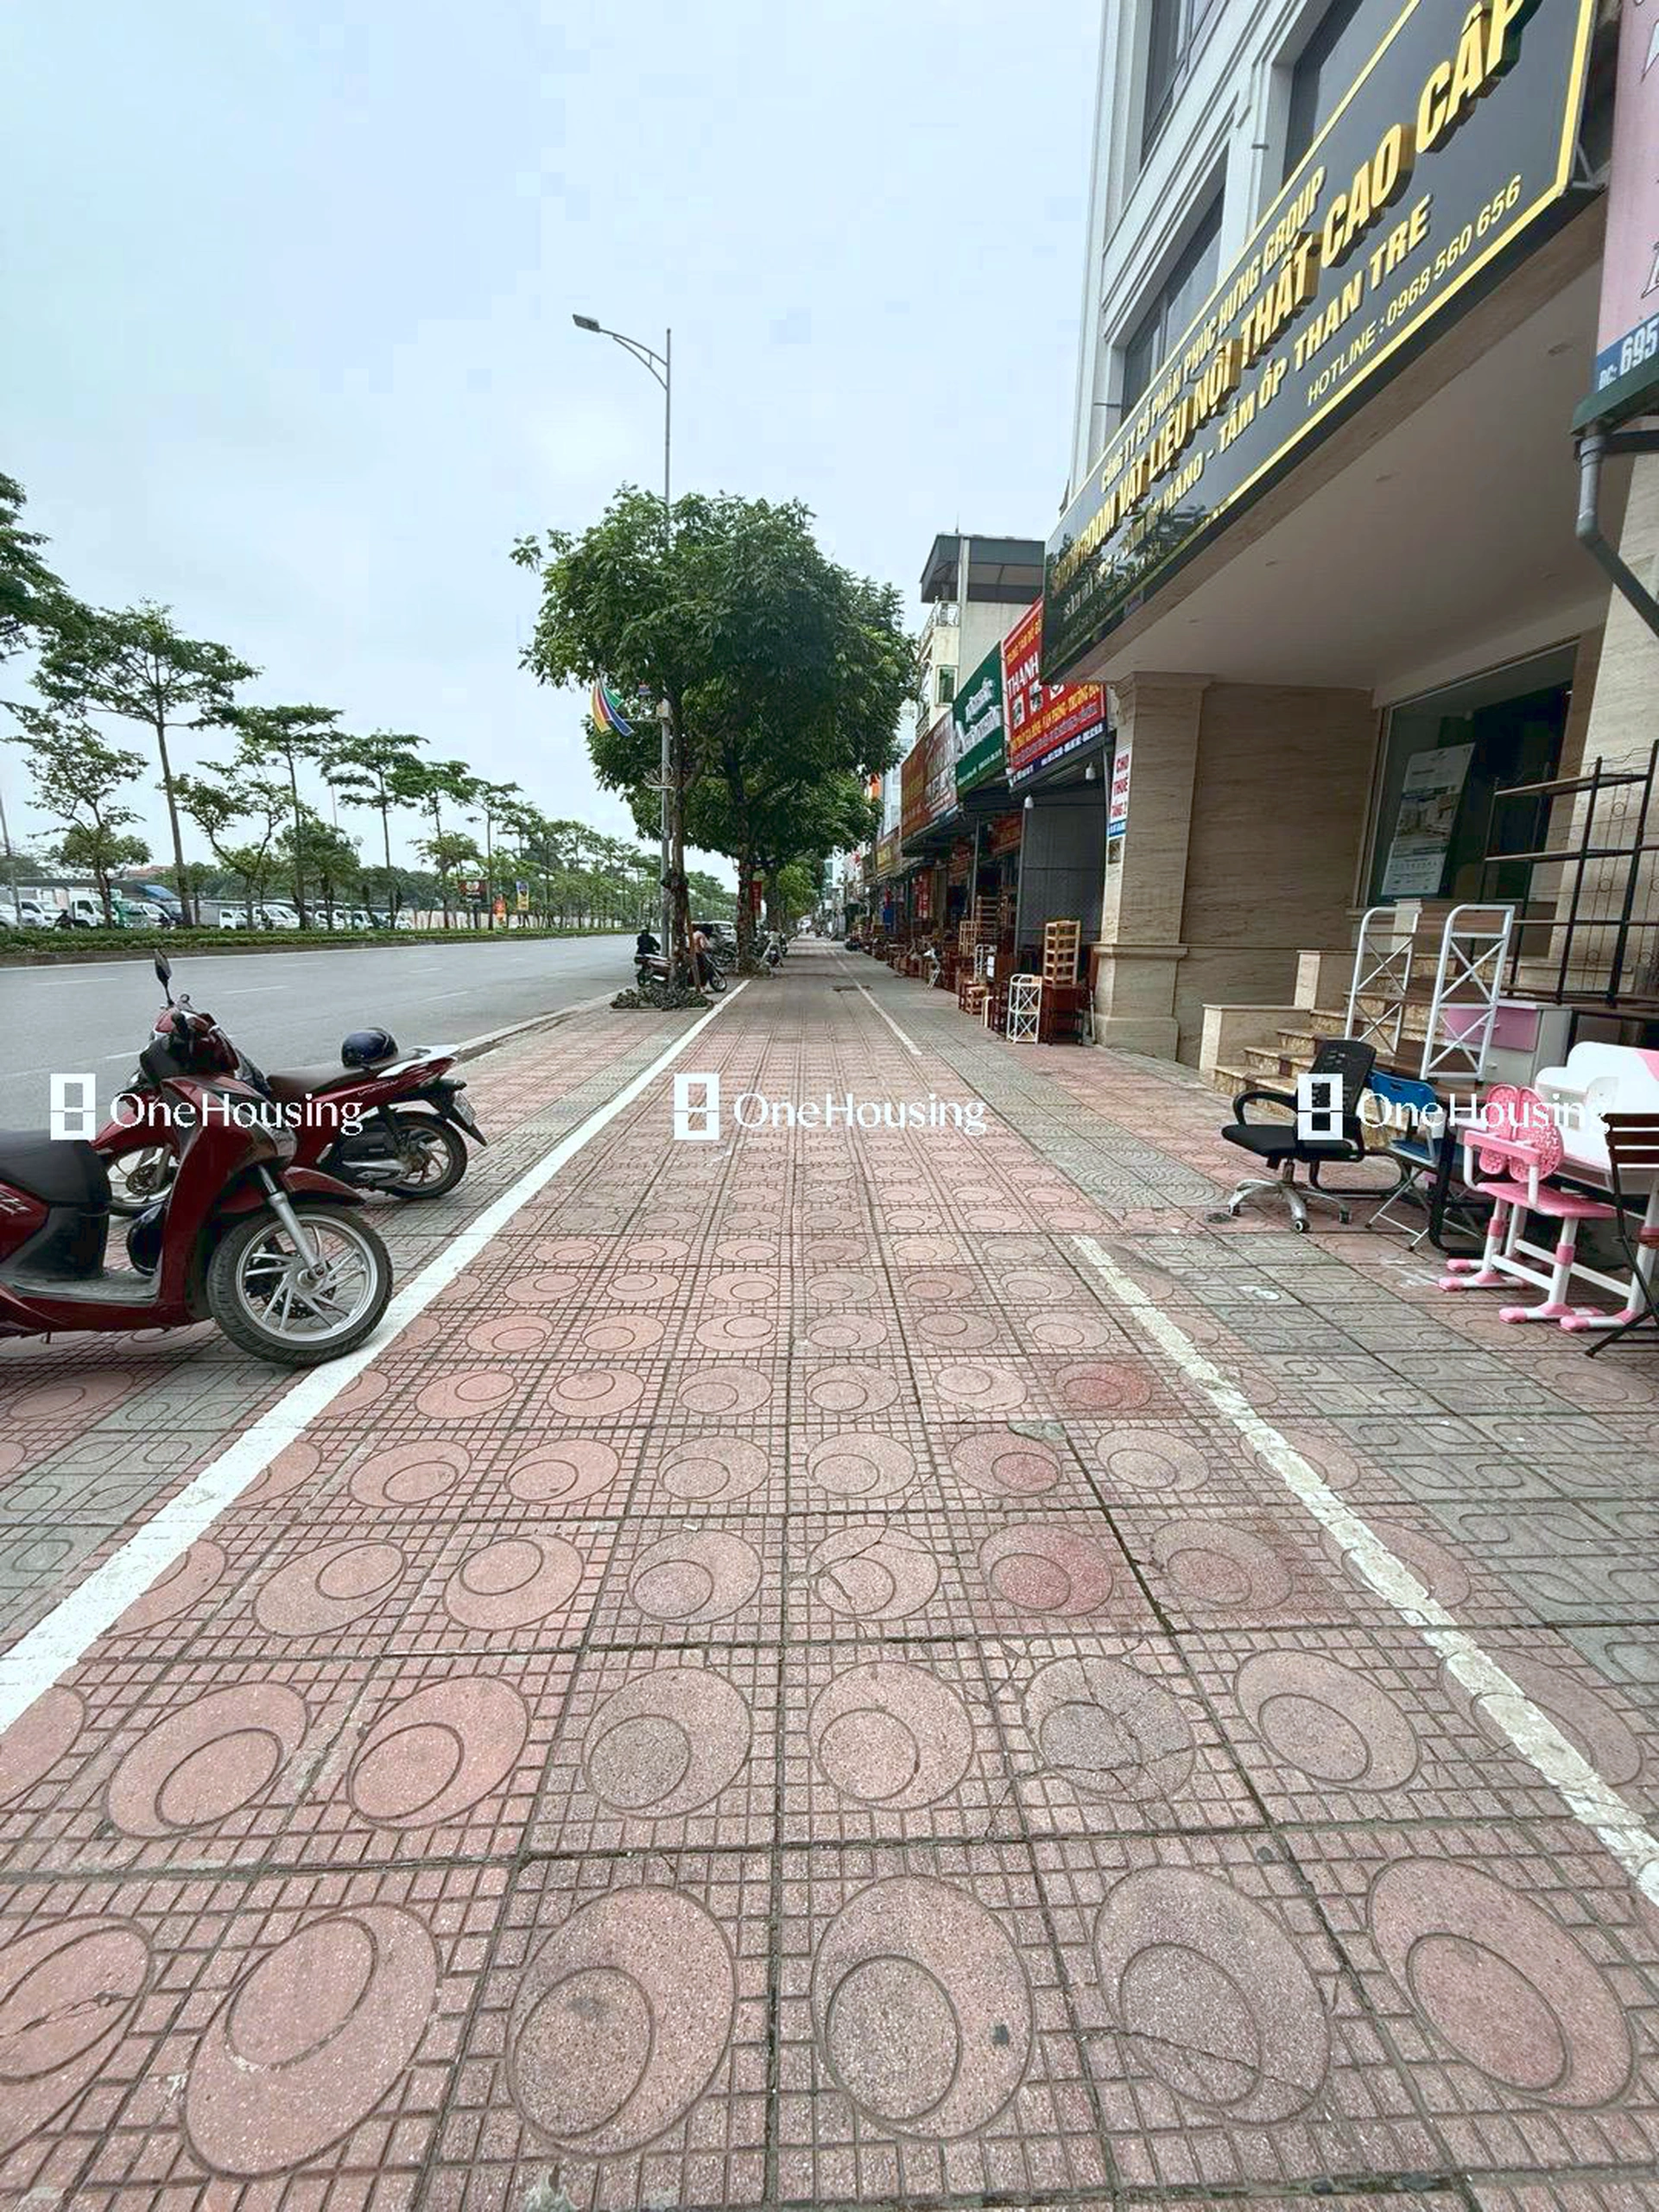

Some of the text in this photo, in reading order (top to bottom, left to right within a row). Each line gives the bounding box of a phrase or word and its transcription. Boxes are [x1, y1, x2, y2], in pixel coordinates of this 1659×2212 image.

[1149, 397, 1188, 482] LIỆU
[1192, 337, 1233, 429] NỘI
[1240, 231, 1313, 369] THẤT
[1320, 123, 1403, 269] CAO
[1219, 390, 1257, 453] TẤM
[1258, 357, 1289, 409] ỐP
[1294, 270, 1365, 371] THAN
[1370, 193, 1433, 291] TRE
[1263, 165, 1327, 275] GROUP
[1308, 320, 1377, 407] HOTLINE
[1386, 266, 1432, 327] 0968
[1433, 225, 1473, 282] 560
[1476, 174, 1523, 239] 656
[1007, 652, 1040, 700] THANH
